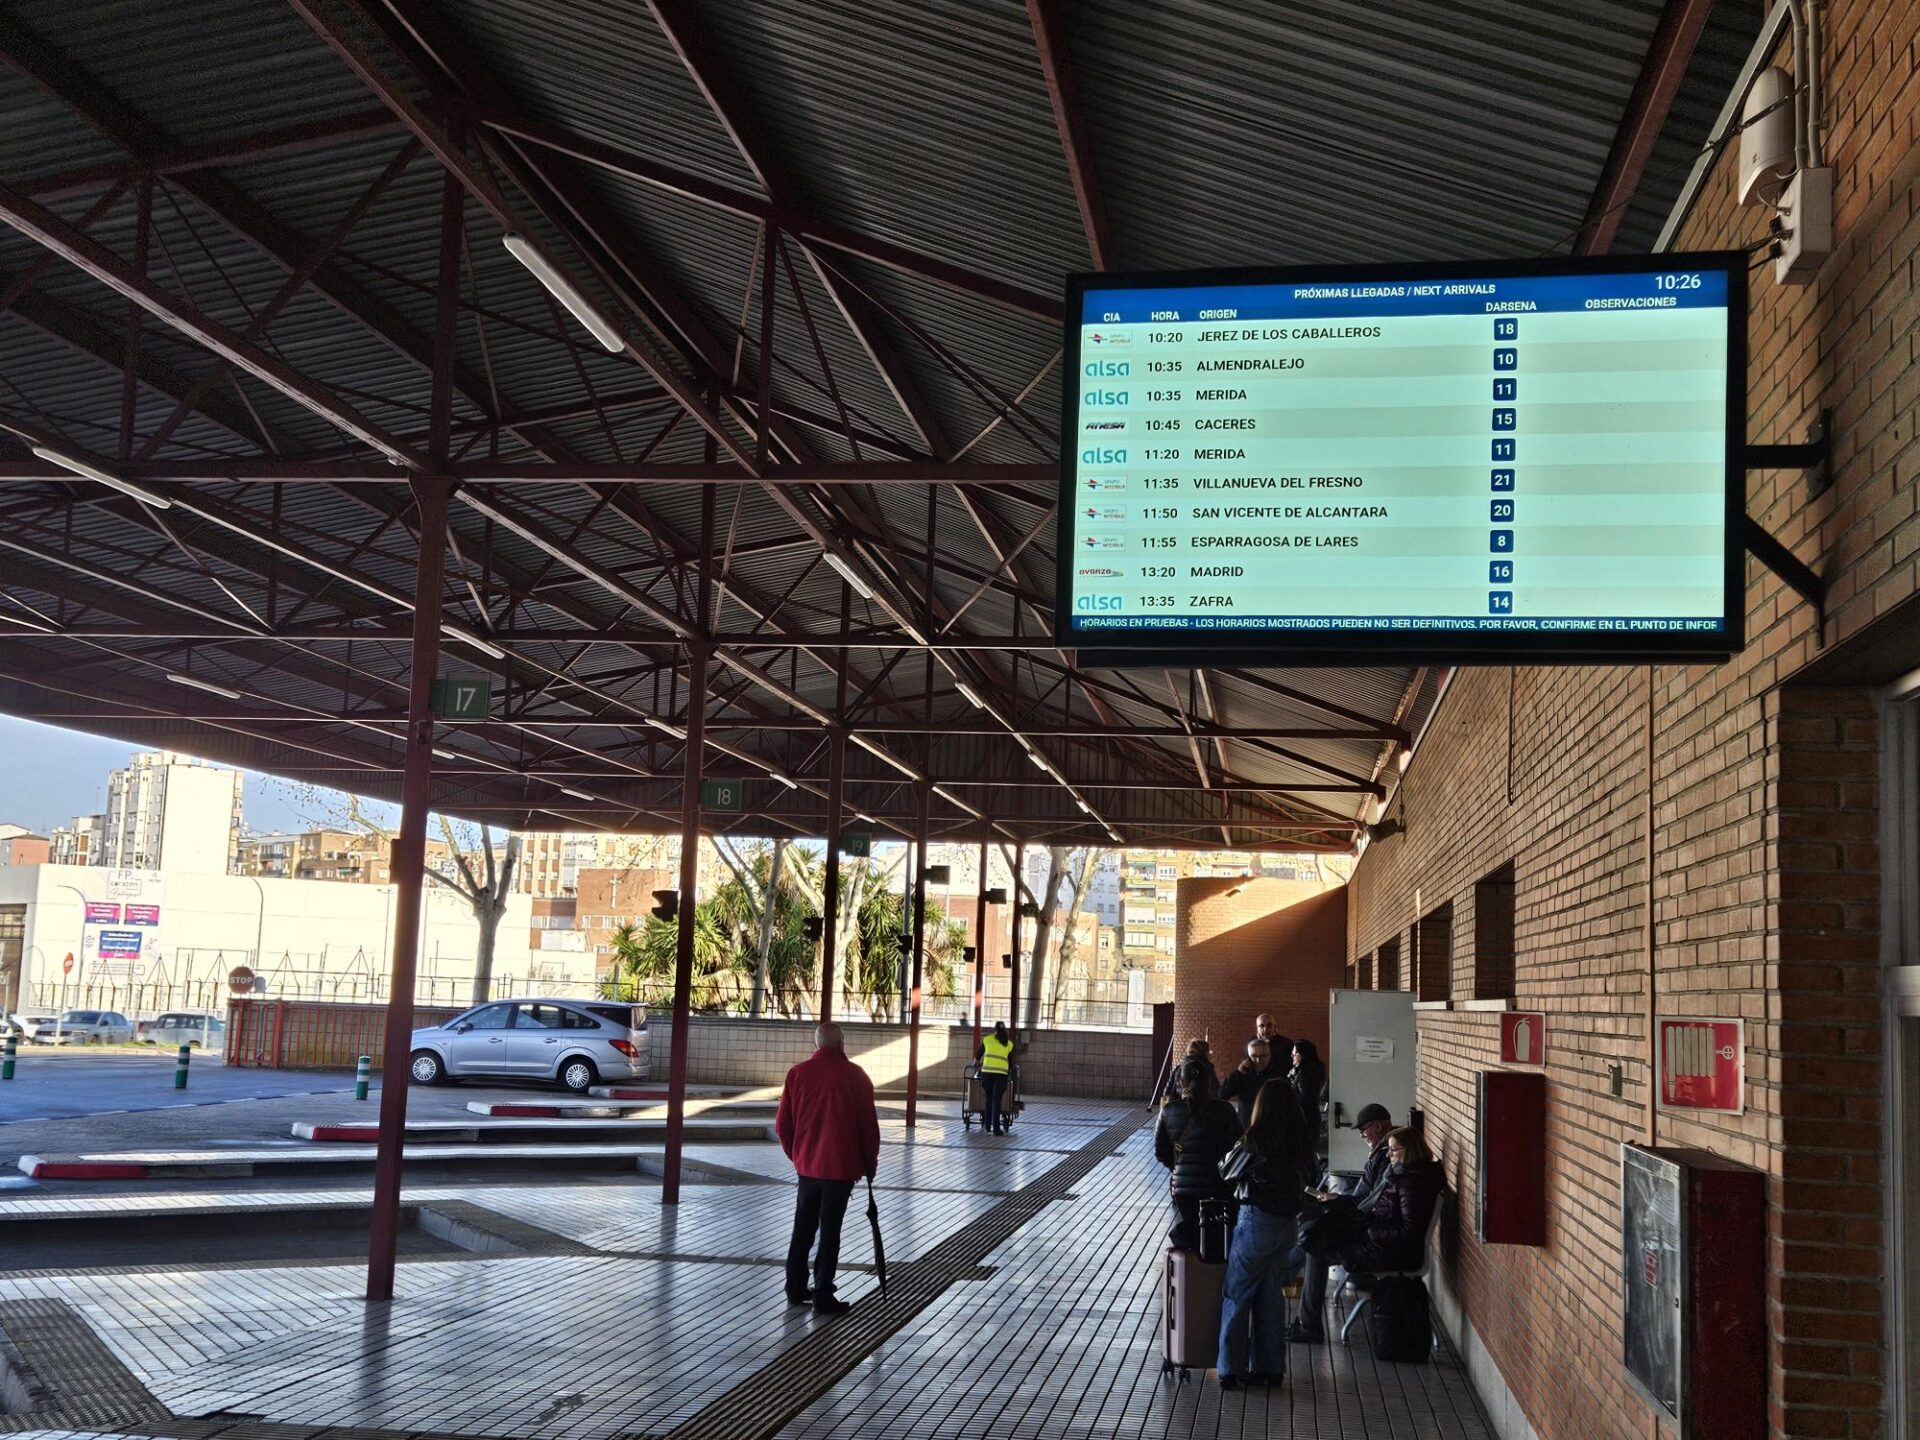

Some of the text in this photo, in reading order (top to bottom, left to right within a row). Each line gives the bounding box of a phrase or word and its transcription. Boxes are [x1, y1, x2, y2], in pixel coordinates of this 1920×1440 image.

[1655, 274, 1701, 290] 10:26
[1294, 287, 1349, 299] PRÓXIMAS
[1351, 287, 1405, 298] LLEGADAS
[1414, 286, 1441, 295] NEXT
[1444, 285, 1496, 294] ARRIVALS
[1485, 301, 1537, 312] DARSENA
[1585, 297, 1677, 309] OBSERVACIONES
[1103, 312, 1120, 322] CIA
[1151, 310, 1179, 321] HORA
[1199, 309, 1237, 320] ORIGEN
[1198, 326, 1381, 342] JEREZ DE LOS CABALLEROS
[1498, 324, 1514, 335] 18
[1148, 332, 1183, 344] 10:20
[1197, 358, 1305, 371] ALMENDRALEJO
[1497, 354, 1514, 365] 10
[1085, 361, 1129, 377] alsa
[1147, 361, 1182, 372] 10:35
[1146, 390, 1181, 401] 10:35
[1196, 389, 1247, 401] MERIDA
[1497, 384, 1512, 395] 11
[1085, 389, 1129, 405] alsa
[1145, 419, 1180, 431] 10:45
[1195, 418, 1256, 430] CACERES
[1496, 414, 1512, 425] 15
[1083, 448, 1127, 463] alsa
[1145, 448, 1179, 460] 11:20
[1194, 449, 1246, 460] MERIDA
[1496, 444, 1511, 455] 11
[1143, 478, 1179, 489] 11:35
[1194, 476, 1363, 489] VILLANUEVA DEL FRESNO
[1494, 474, 1510, 486] 21
[1142, 507, 1178, 519] 11:50
[1193, 506, 1388, 519] SAN VICENTE DE ALCANTARA
[1494, 505, 1511, 516] 20
[1141, 537, 1177, 548] 11:55
[1191, 536, 1358, 548] ESPARRAGOSA DE LARES
[1498, 536, 1506, 547] 8
[1141, 566, 1176, 578] 13:20
[1190, 566, 1243, 577] MADRID
[1493, 566, 1510, 577] 16
[1078, 594, 1121, 610] alsa
[1140, 596, 1175, 607] 13:35
[1190, 596, 1234, 607] ZAFRA
[1493, 597, 1509, 608] 14
[1080, 619, 1127, 627] HORARIOS
[1130, 619, 1142, 627] EN
[1145, 618, 1188, 627] PRUEBAS
[1196, 619, 1214, 628] LOS
[1216, 618, 1265, 628] HORARIOS
[1268, 619, 1330, 628] MOSTRADOS
[1332, 619, 1372, 628] PUEDEN
[1375, 619, 1389, 628] NO
[1391, 620, 1411, 628] SER
[1413, 620, 1477, 629] DEFINITIVOS.
[1480, 620, 1501, 629] POR
[1504, 620, 1539, 630] FAVOR,
[1541, 620, 1596, 629] CONFIRME
[1599, 620, 1613, 629] EN
[1616, 620, 1628, 629] EL
[1630, 620, 1667, 629] PUNTO
[1669, 621, 1684, 629] DE
[456, 687, 477, 712] 17
[717, 789, 731, 805] 18
[851, 840, 864, 852] 19
[230, 976, 253, 984] STOP
